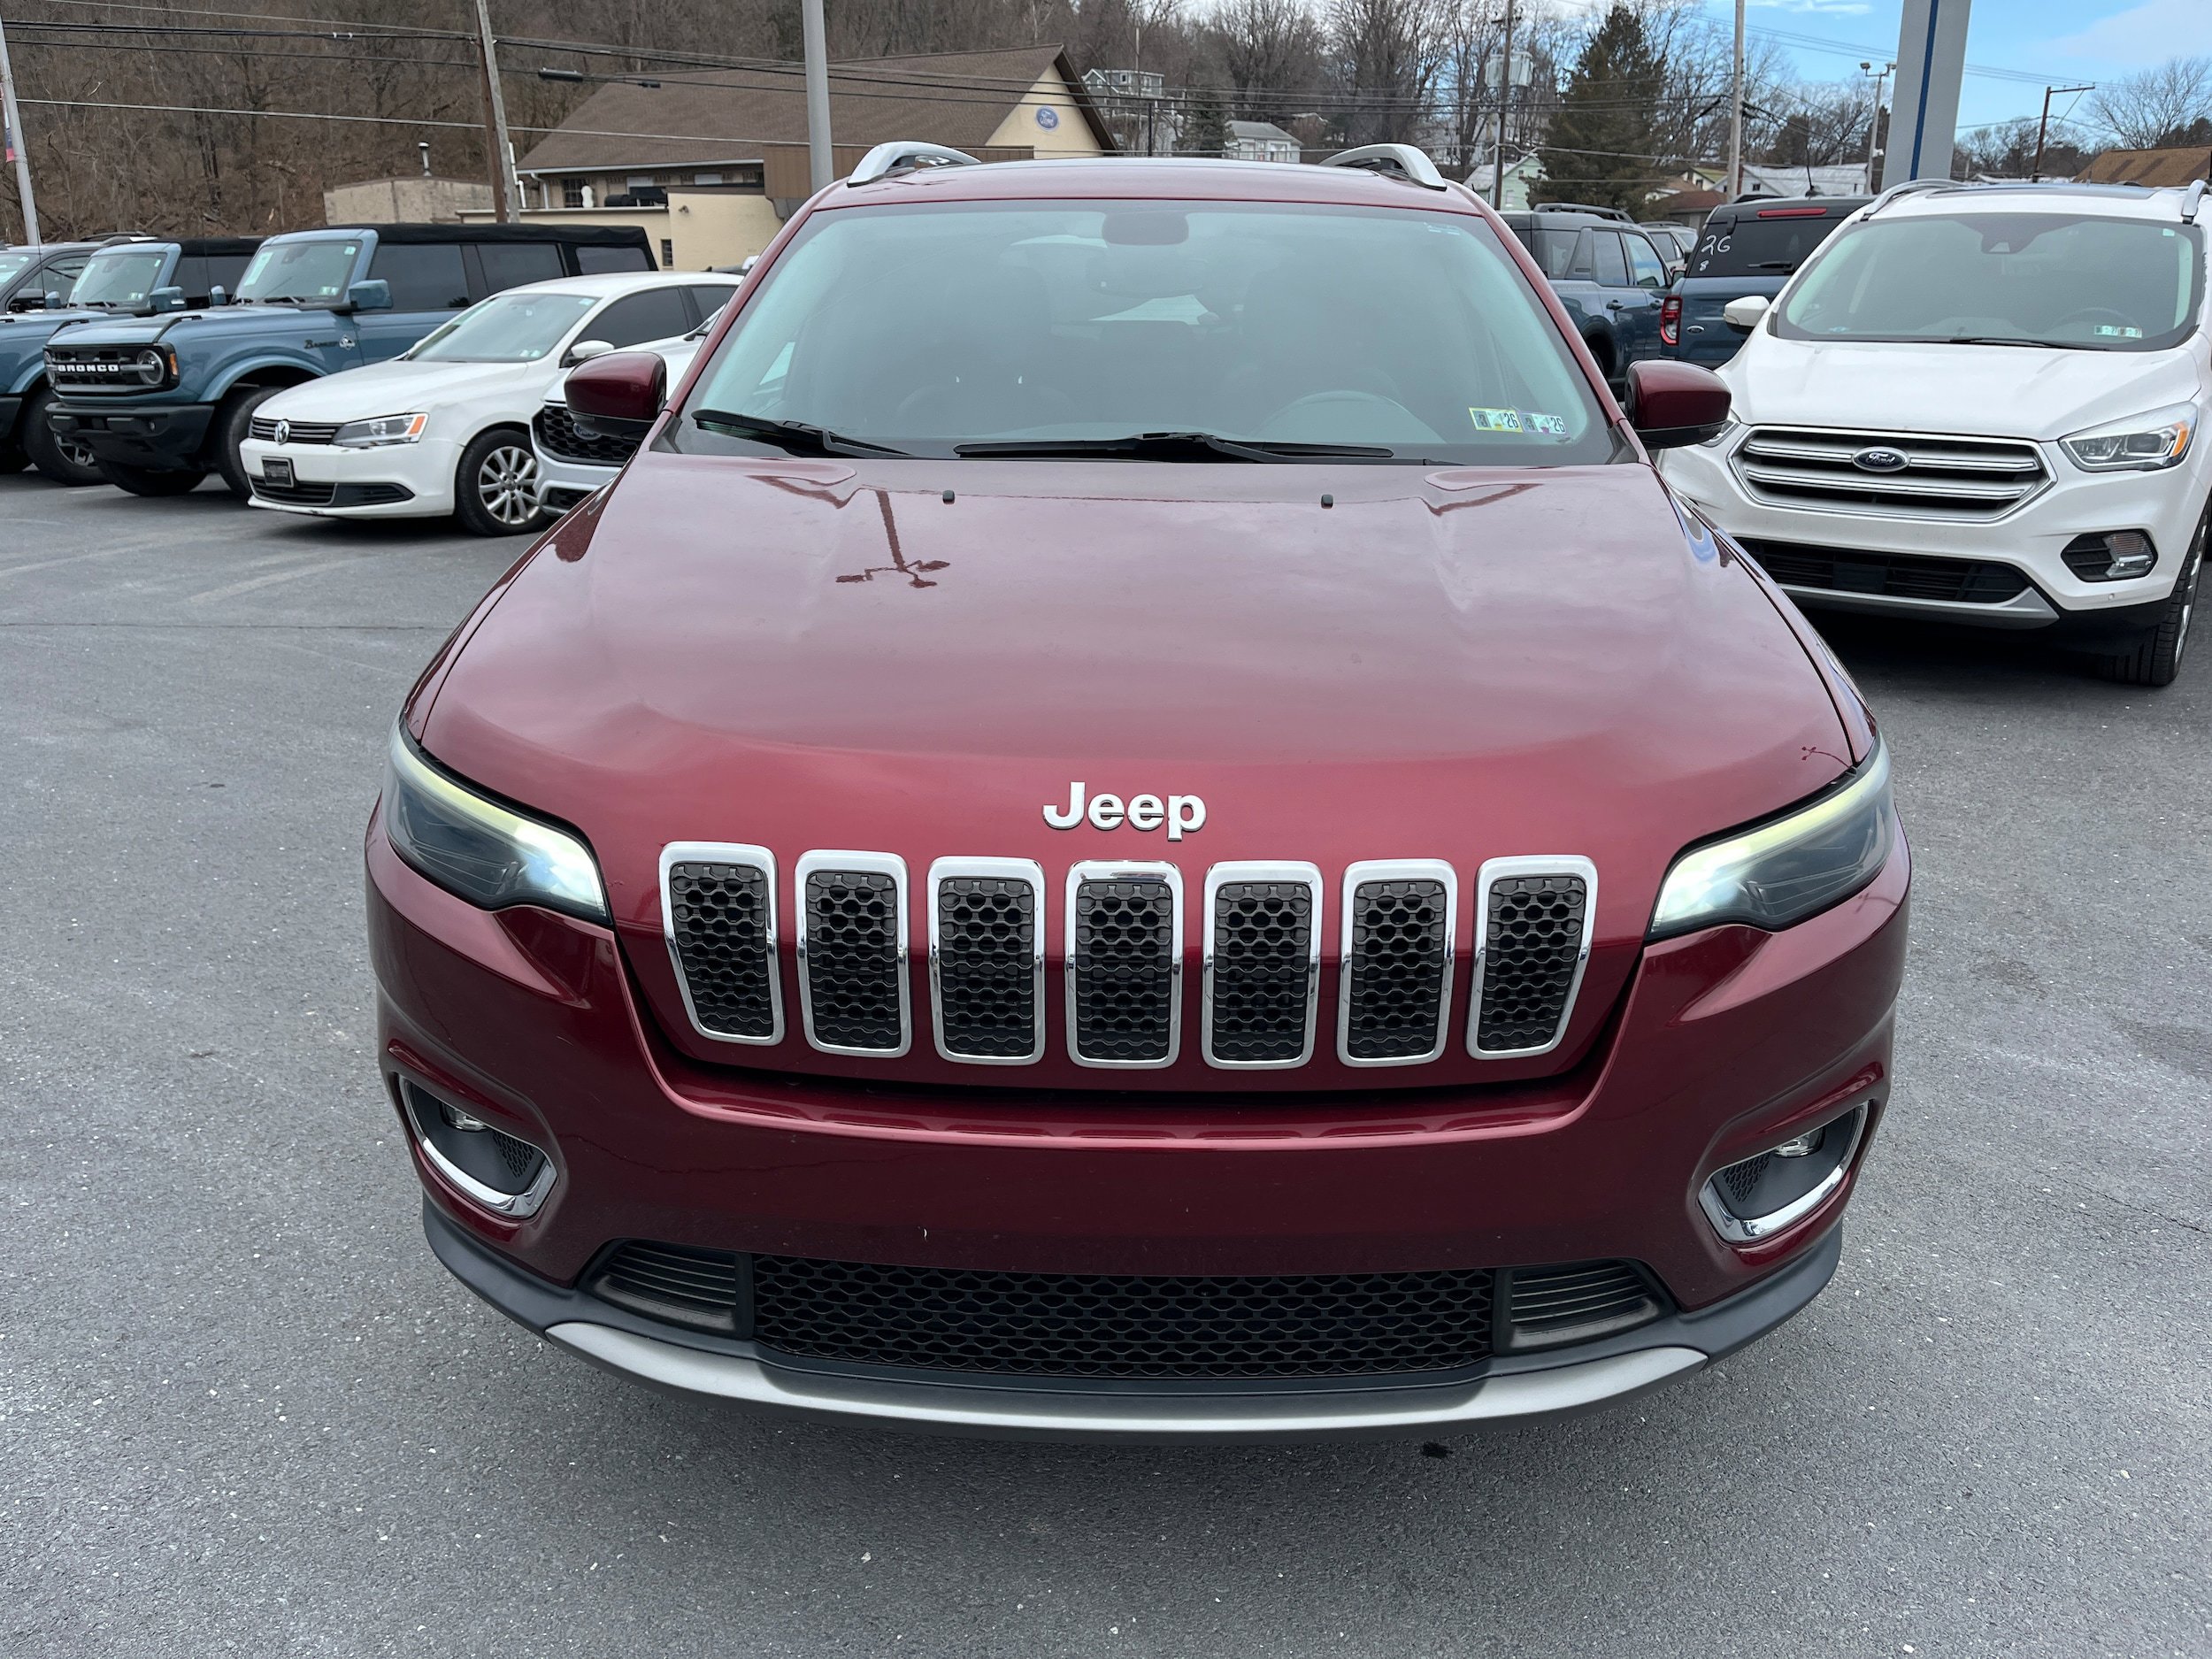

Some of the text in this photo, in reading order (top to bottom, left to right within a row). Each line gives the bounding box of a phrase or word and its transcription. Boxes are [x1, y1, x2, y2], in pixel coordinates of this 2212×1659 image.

[1504, 412, 1519, 428] 26
[1550, 417, 1566, 432] 26
[1866, 452, 1896, 465] Ford
[1042, 781, 1207, 841] Jeep
